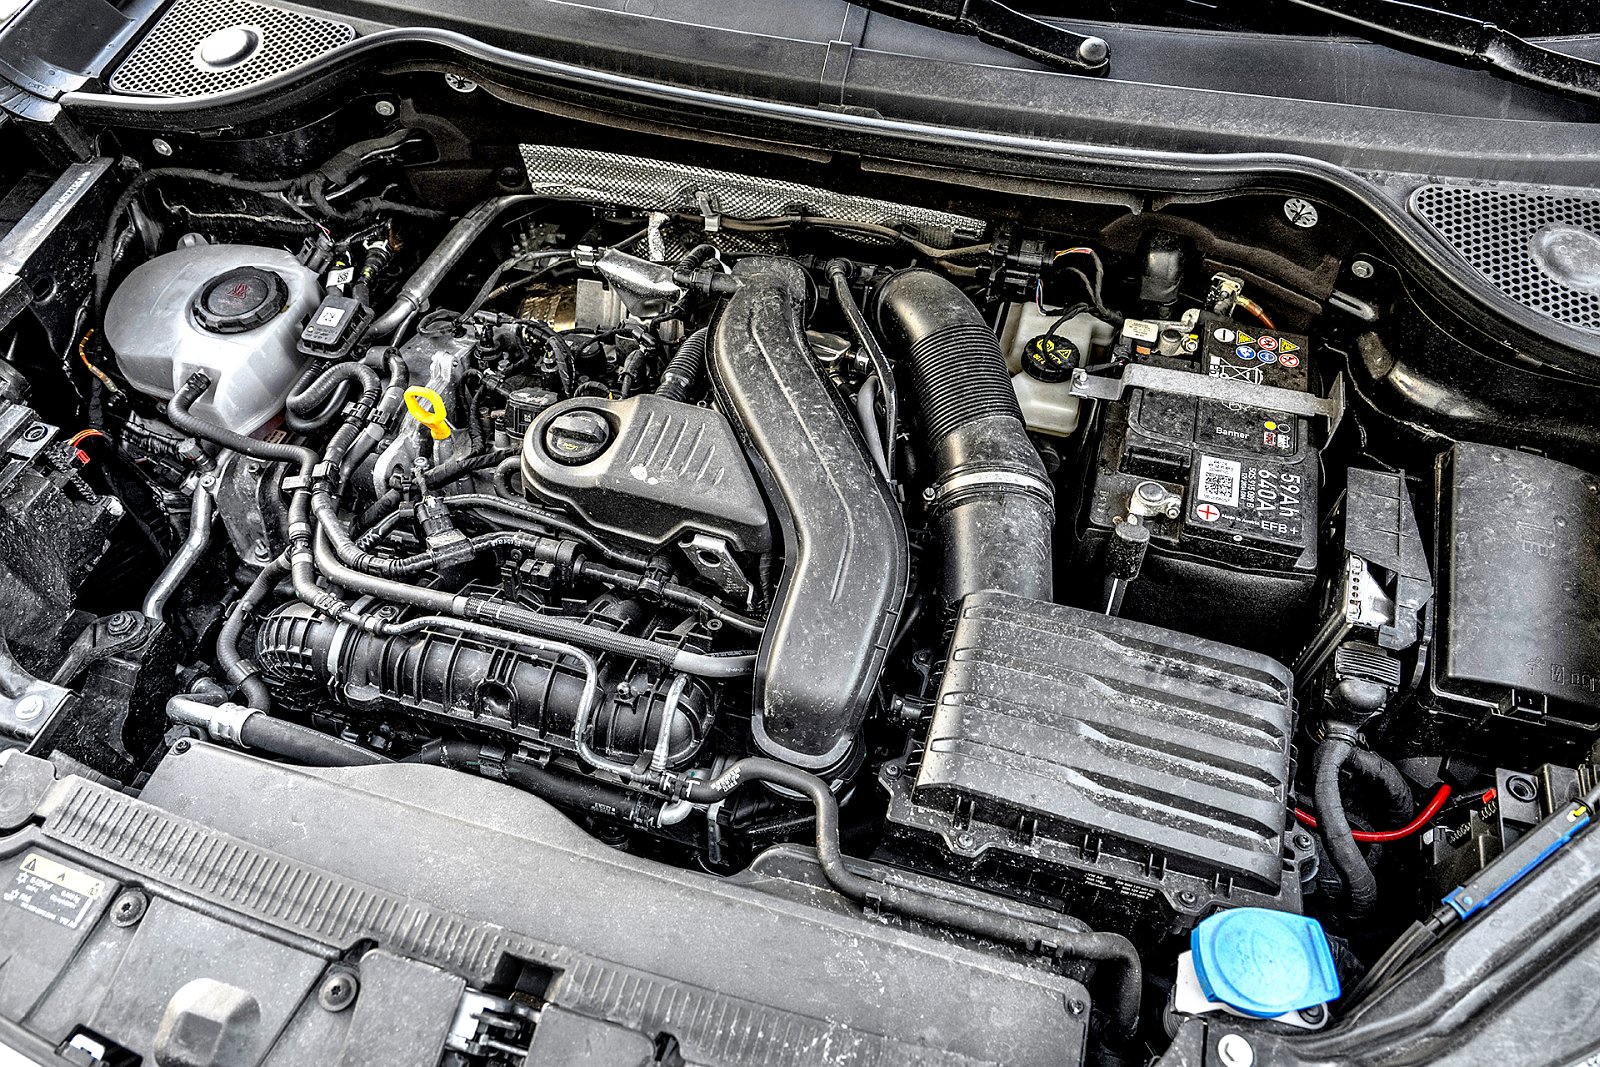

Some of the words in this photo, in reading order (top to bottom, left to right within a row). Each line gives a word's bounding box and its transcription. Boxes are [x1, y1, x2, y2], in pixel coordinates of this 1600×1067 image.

[1215, 426, 1250, 439] Banner
[1256, 469, 1278, 511] 640A
[1280, 473, 1301, 517] 59Ah
[1261, 520, 1288, 534] EFB
